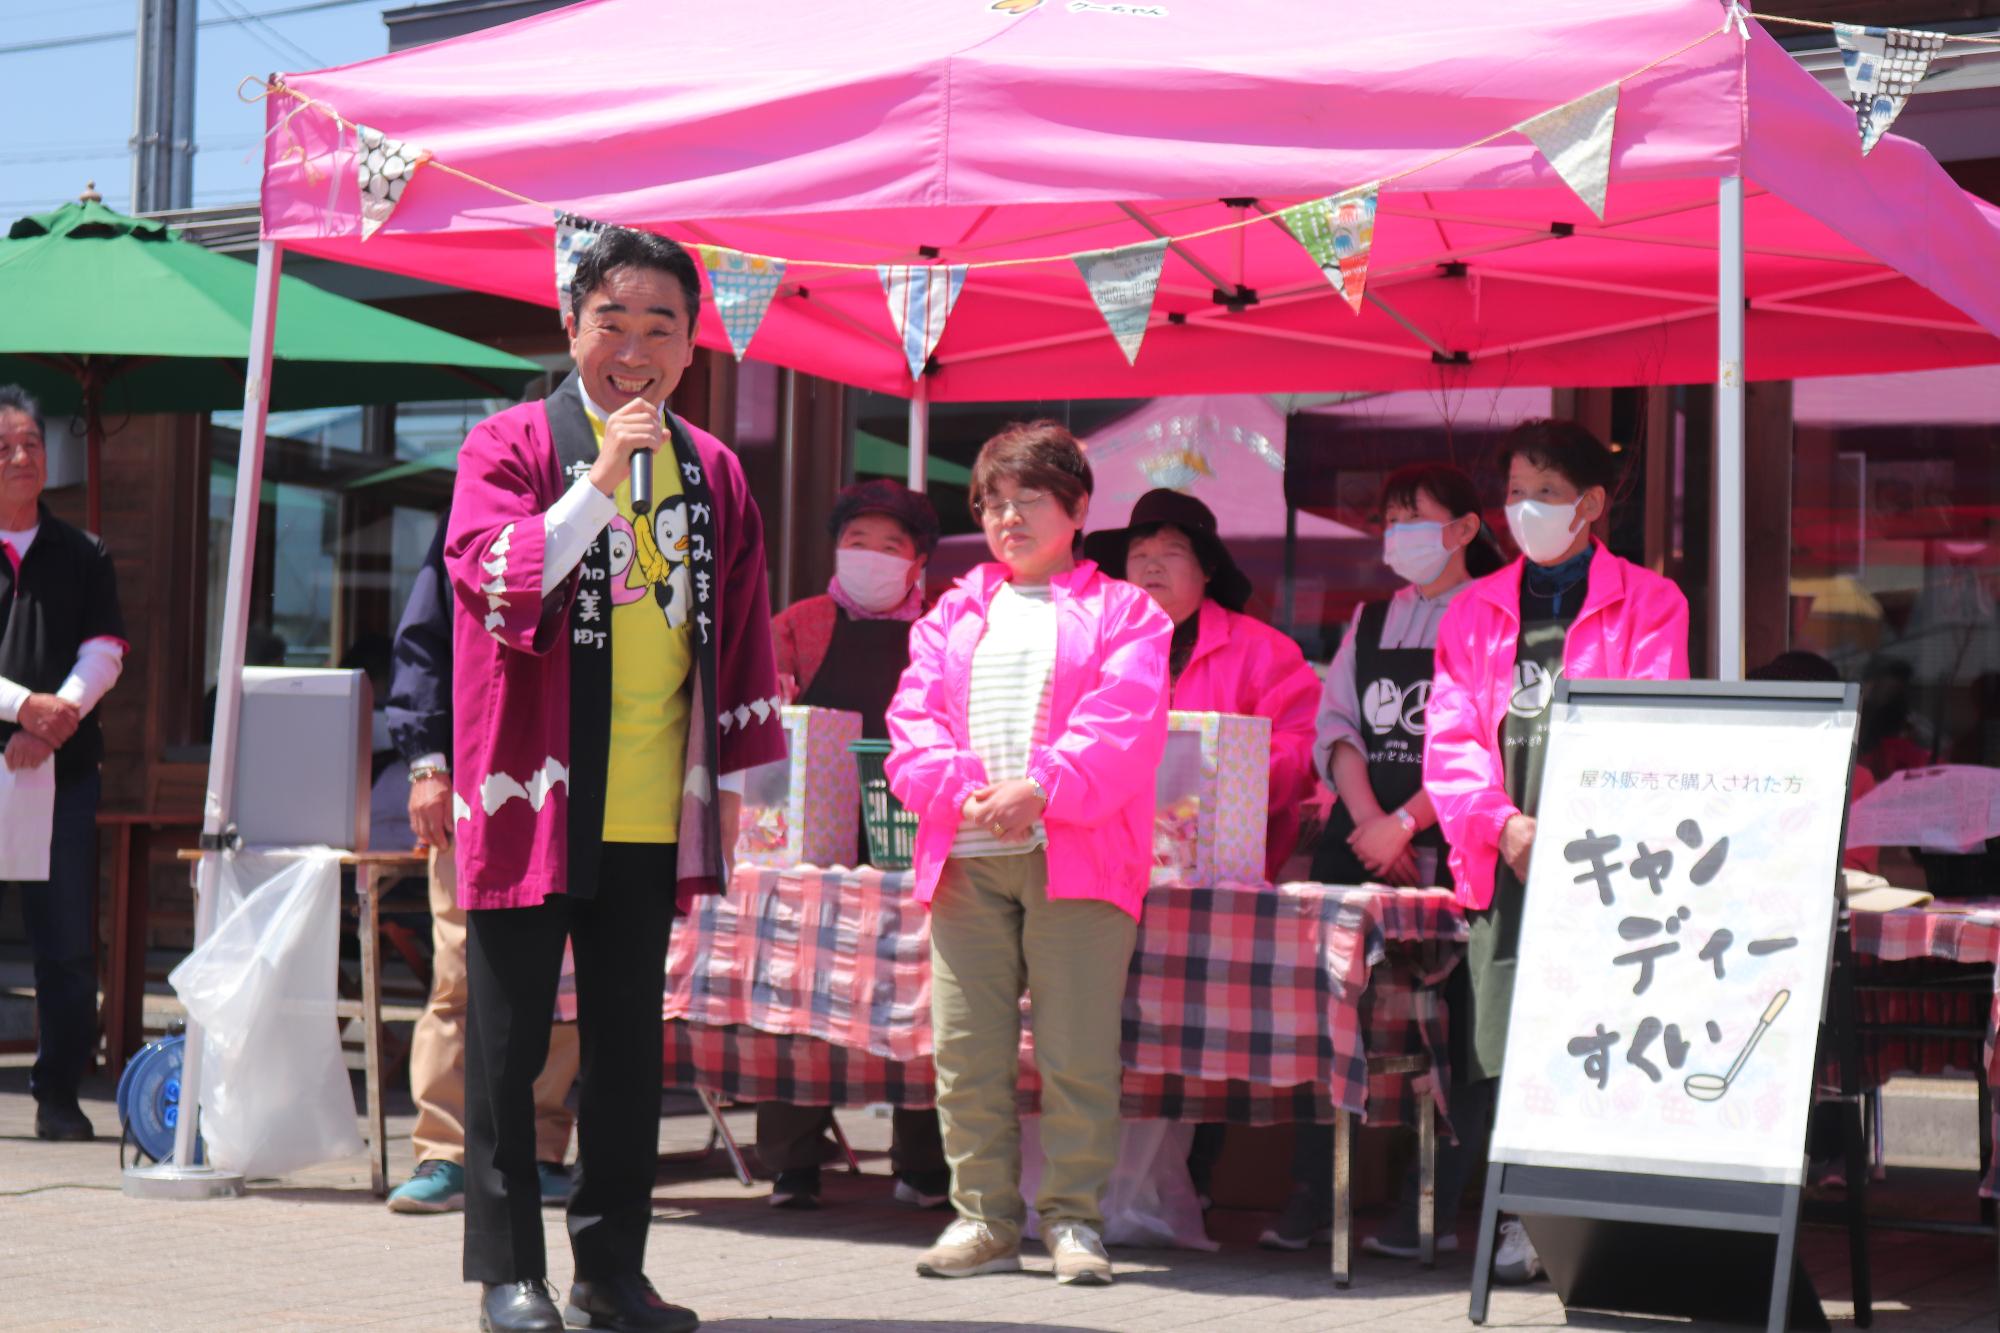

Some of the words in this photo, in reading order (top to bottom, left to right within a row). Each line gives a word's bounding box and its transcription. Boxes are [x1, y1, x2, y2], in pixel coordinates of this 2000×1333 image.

[1579, 769, 1804, 794] 屋外販売で購入された方
[1564, 818, 1729, 906] キャン
[1612, 905, 1798, 995] ディー
[1566, 1016, 1722, 1090] すくい
